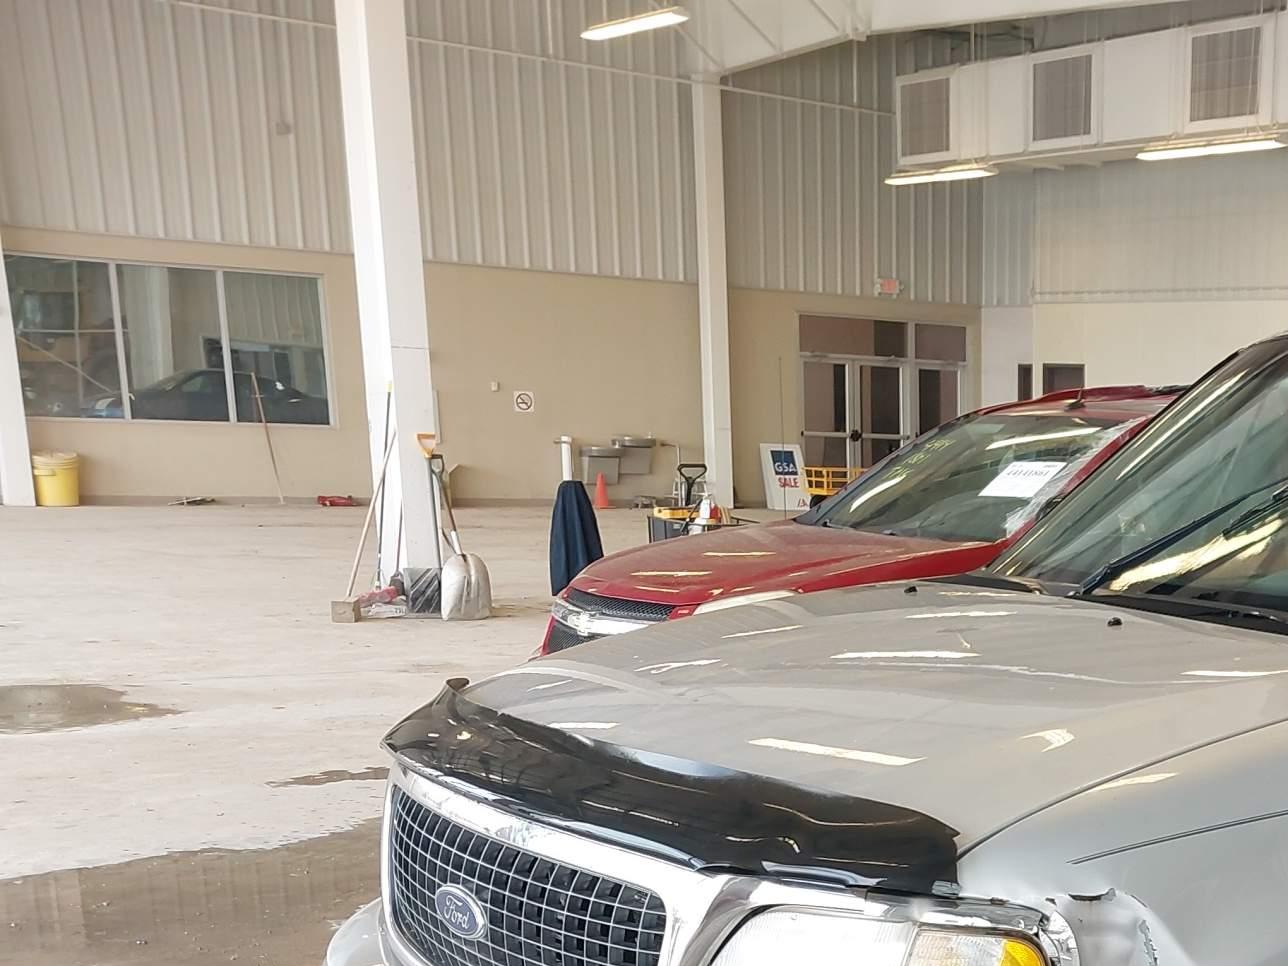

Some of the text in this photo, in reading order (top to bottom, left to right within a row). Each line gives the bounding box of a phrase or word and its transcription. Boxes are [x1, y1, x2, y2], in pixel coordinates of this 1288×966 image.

[774, 462, 797, 473] GSA
[778, 477, 800, 488] SALE
[444, 895, 470, 930] Ford
